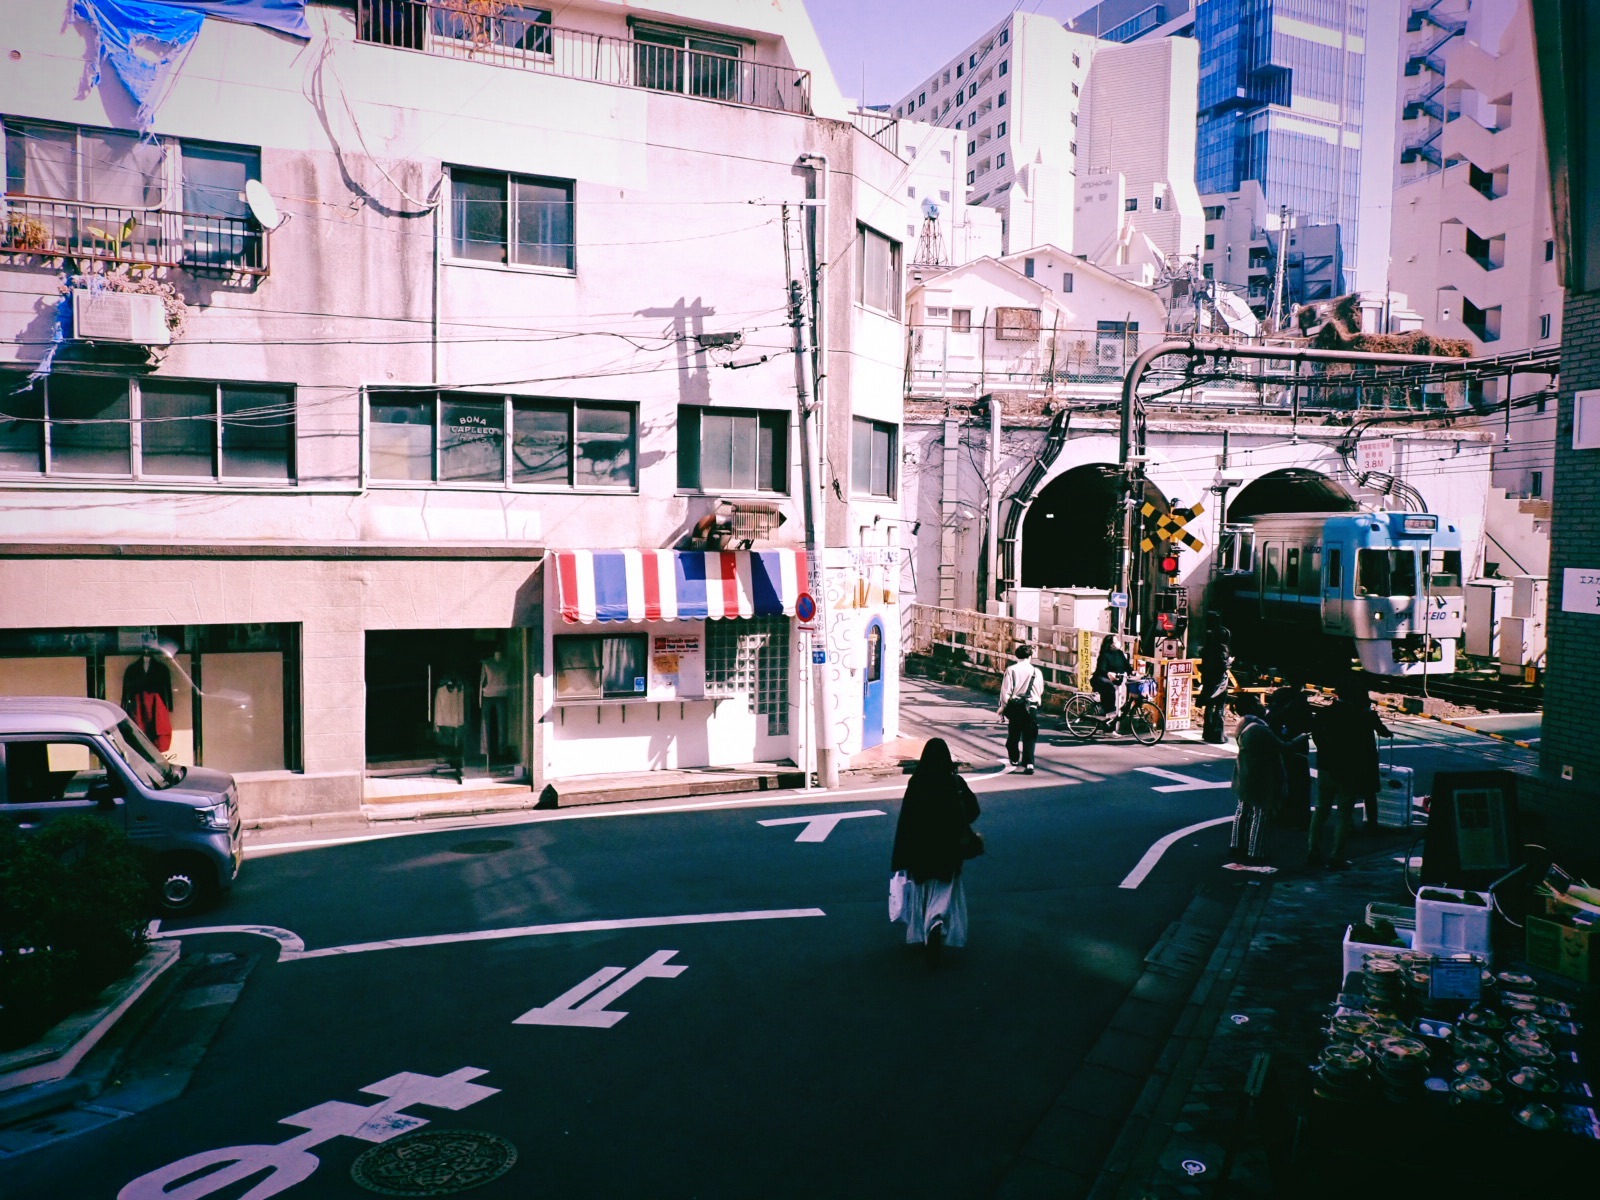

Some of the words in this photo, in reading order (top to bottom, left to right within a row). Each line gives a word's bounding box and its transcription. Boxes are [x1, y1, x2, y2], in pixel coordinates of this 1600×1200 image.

[460, 416, 487, 425] BONA
[1364, 460, 1384, 469] 3.8M
[1169, 663, 1191, 674] 危険!!
[1170, 677, 1180, 718] 立入禁止
